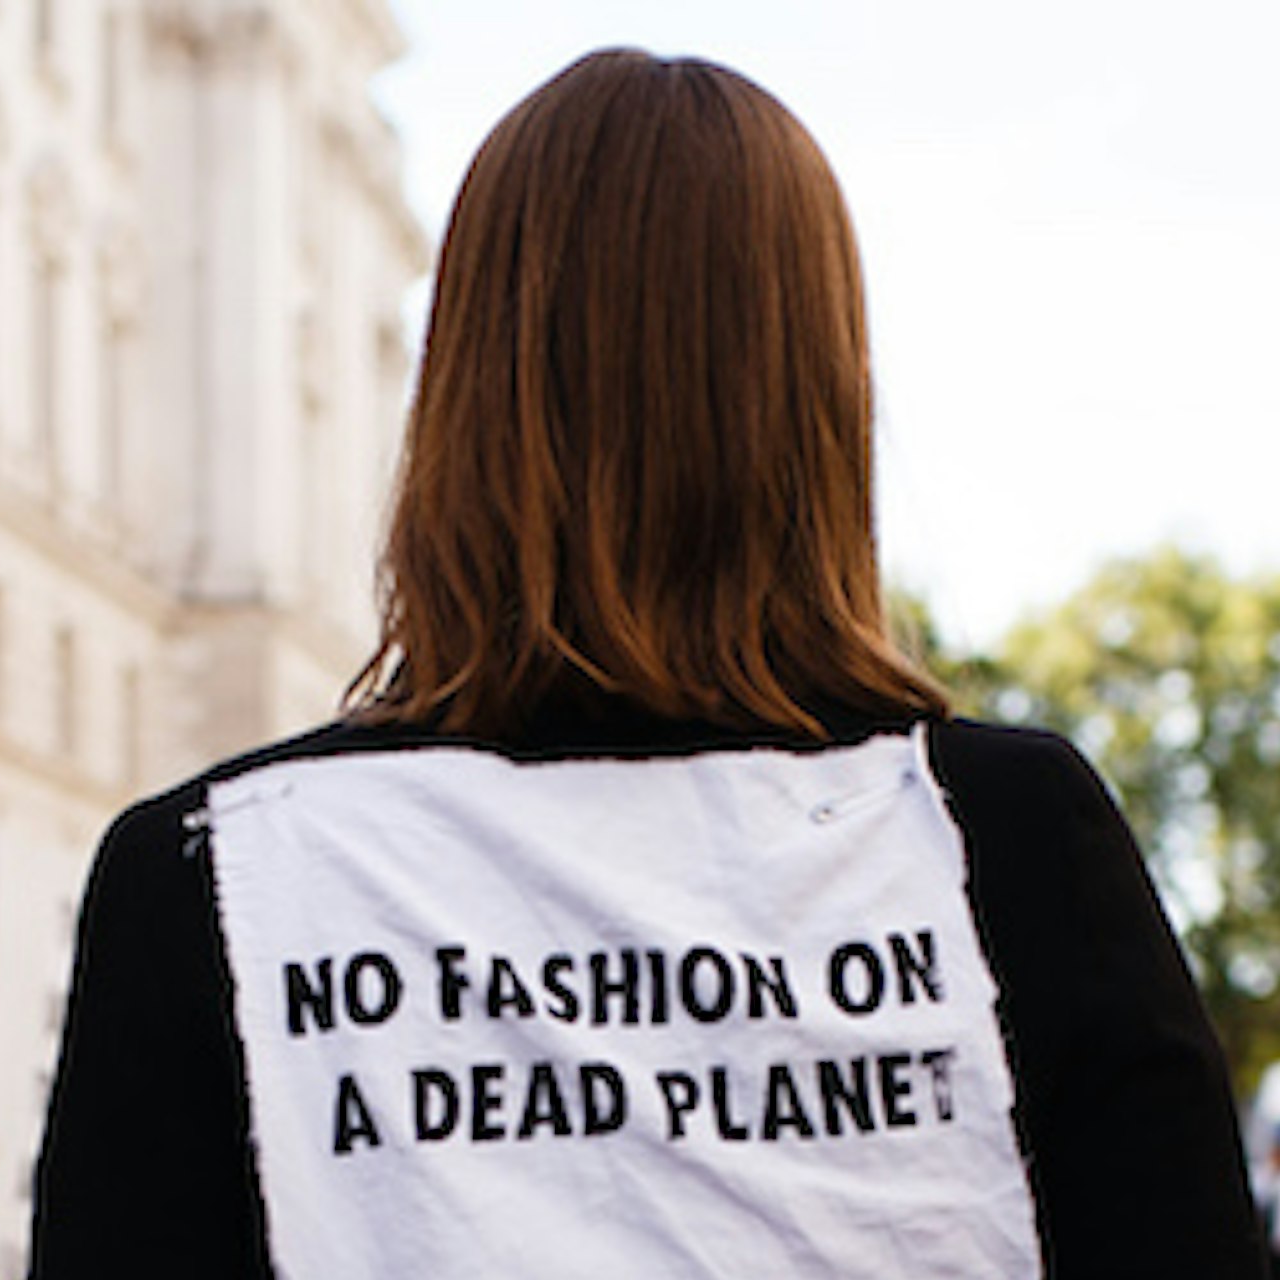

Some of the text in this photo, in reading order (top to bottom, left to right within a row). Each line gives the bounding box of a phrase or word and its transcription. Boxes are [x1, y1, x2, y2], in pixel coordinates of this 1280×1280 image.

[282, 929, 944, 1039] NO FASHION ON
[332, 1046, 956, 1157] A DEAD PLANET
